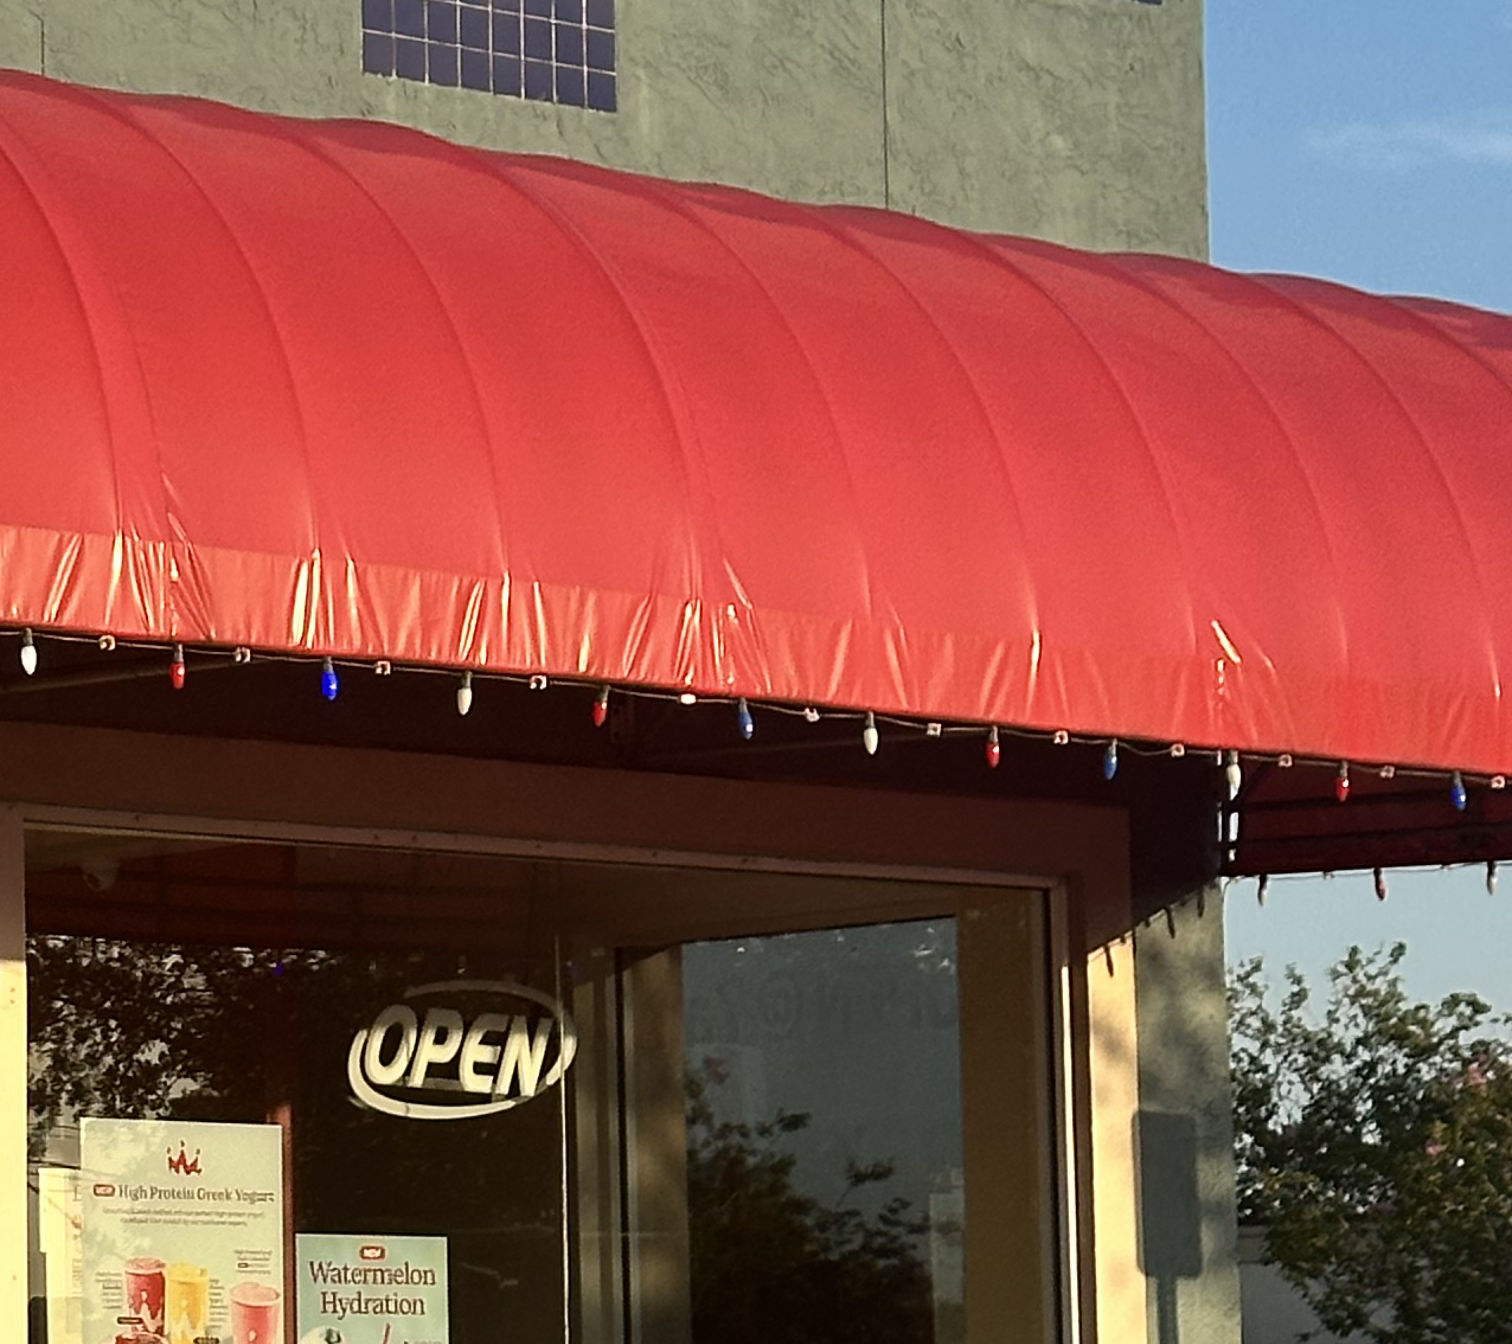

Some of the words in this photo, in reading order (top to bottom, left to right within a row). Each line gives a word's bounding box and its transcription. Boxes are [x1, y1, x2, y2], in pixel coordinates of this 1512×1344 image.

[364, 1004, 556, 1098] OPEN
[118, 1184, 148, 1202] High
[149, 1186, 195, 1201] Protein
[196, 1187, 233, 1202] Greek
[308, 1260, 437, 1286] Watermelon
[319, 1290, 426, 1320] Hydration
